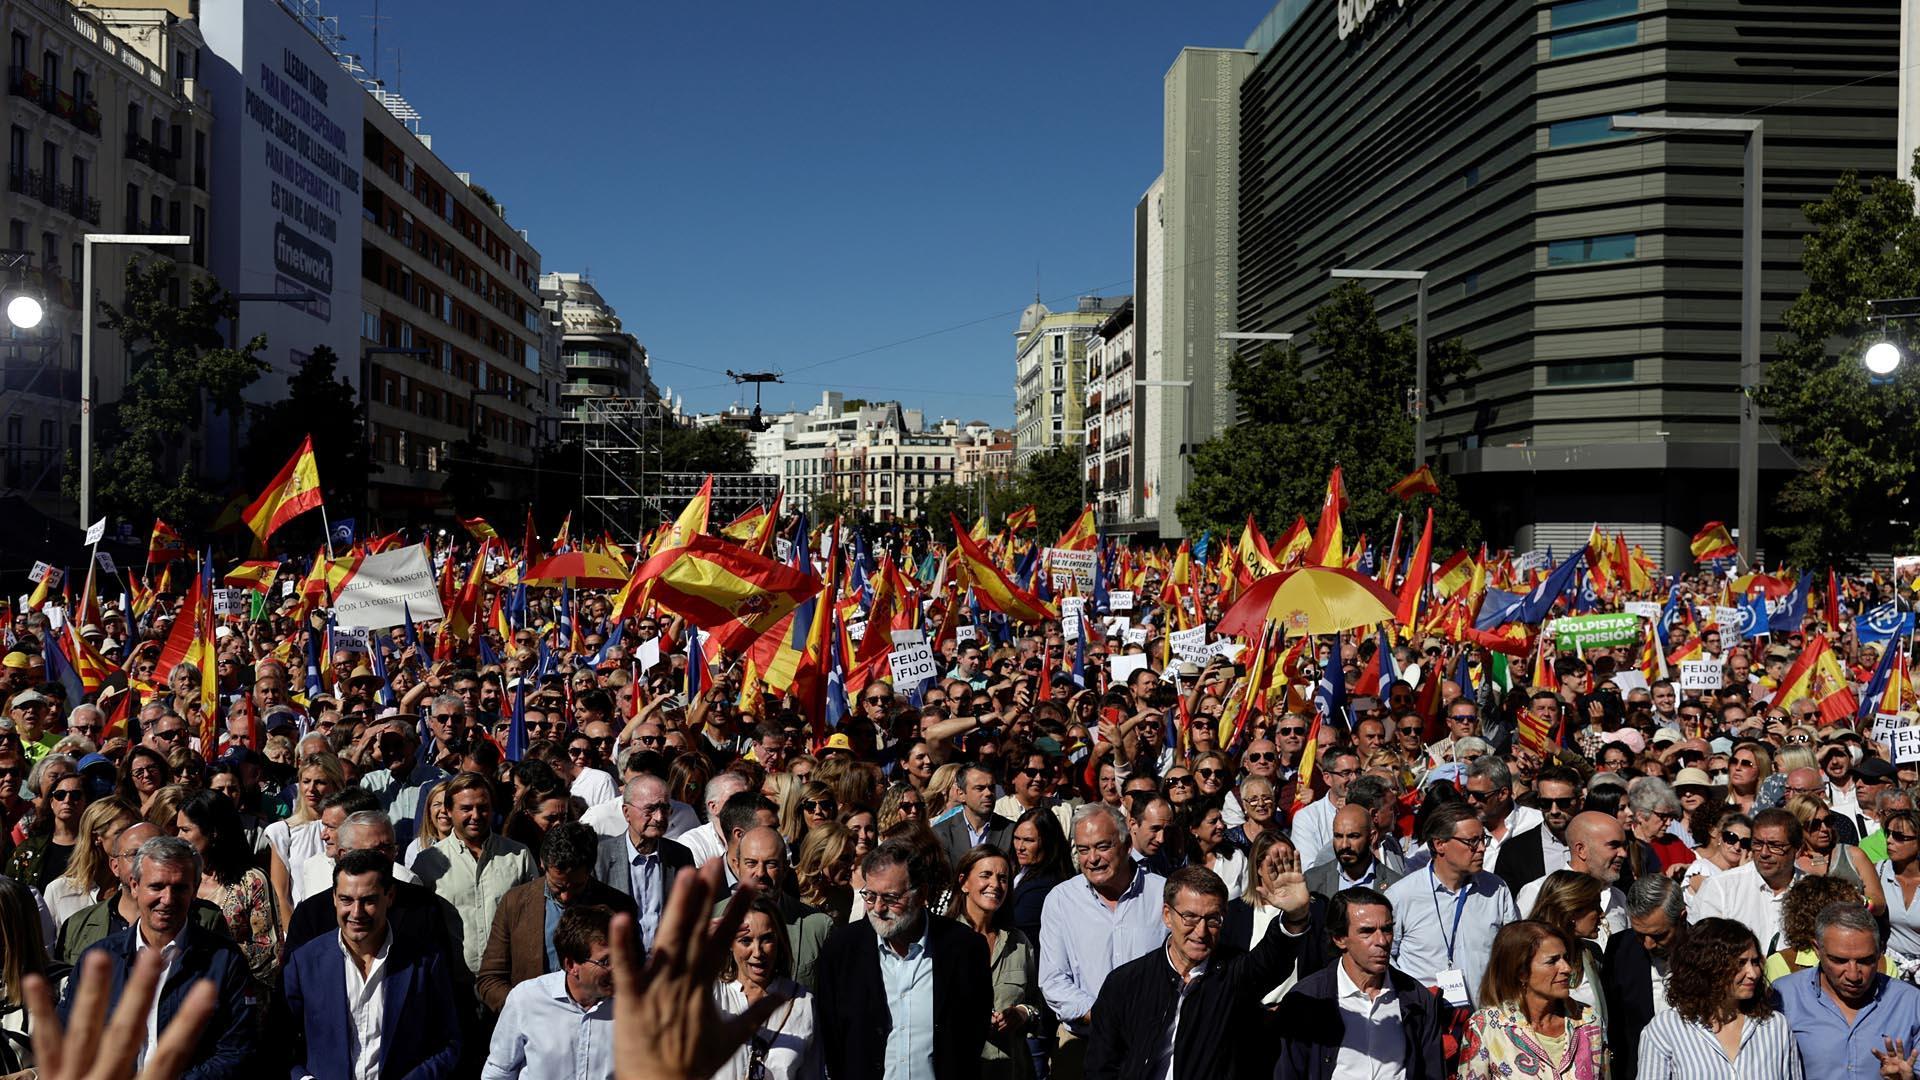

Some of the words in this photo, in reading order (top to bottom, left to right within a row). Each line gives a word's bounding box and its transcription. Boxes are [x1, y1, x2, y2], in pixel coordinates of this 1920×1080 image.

[283, 47, 308, 91] LLEGAR
[309, 69, 328, 107] TARDE
[261, 62, 280, 101] PARA
[280, 79, 290, 111] NO
[290, 87, 311, 126] ESTAR
[245, 86, 274, 134] PORQUE
[275, 111, 297, 150] SABES
[297, 128, 310, 160] QUE
[341, 161, 359, 194] TARDE
[265, 141, 283, 175] PARA
[283, 154, 294, 183] NO
[295, 161, 329, 207] ESPERARTE
[271, 180, 280, 211] ES
[281, 188, 294, 218] TAN
[294, 196, 303, 224] DE
[319, 211, 337, 244] COMO
[277, 233, 331, 285] finetwork
[381, 577, 393, 586] LA
[394, 570, 429, 585] MANCHA
[338, 603, 357, 613] CON
[360, 600, 371, 609] LA
[372, 589, 435, 607] CONSTITUCION
[1559, 617, 1633, 632] GOLPISTAS
[1561, 635, 1571, 645] A
[1575, 627, 1636, 643] PRISIÓN
[891, 650, 932, 667] FEIJO,
[1683, 665, 1722, 673] FEIJO,
[896, 662, 933, 681] ¡FIJO!
[1685, 676, 1719, 686] ¡FIJO!
